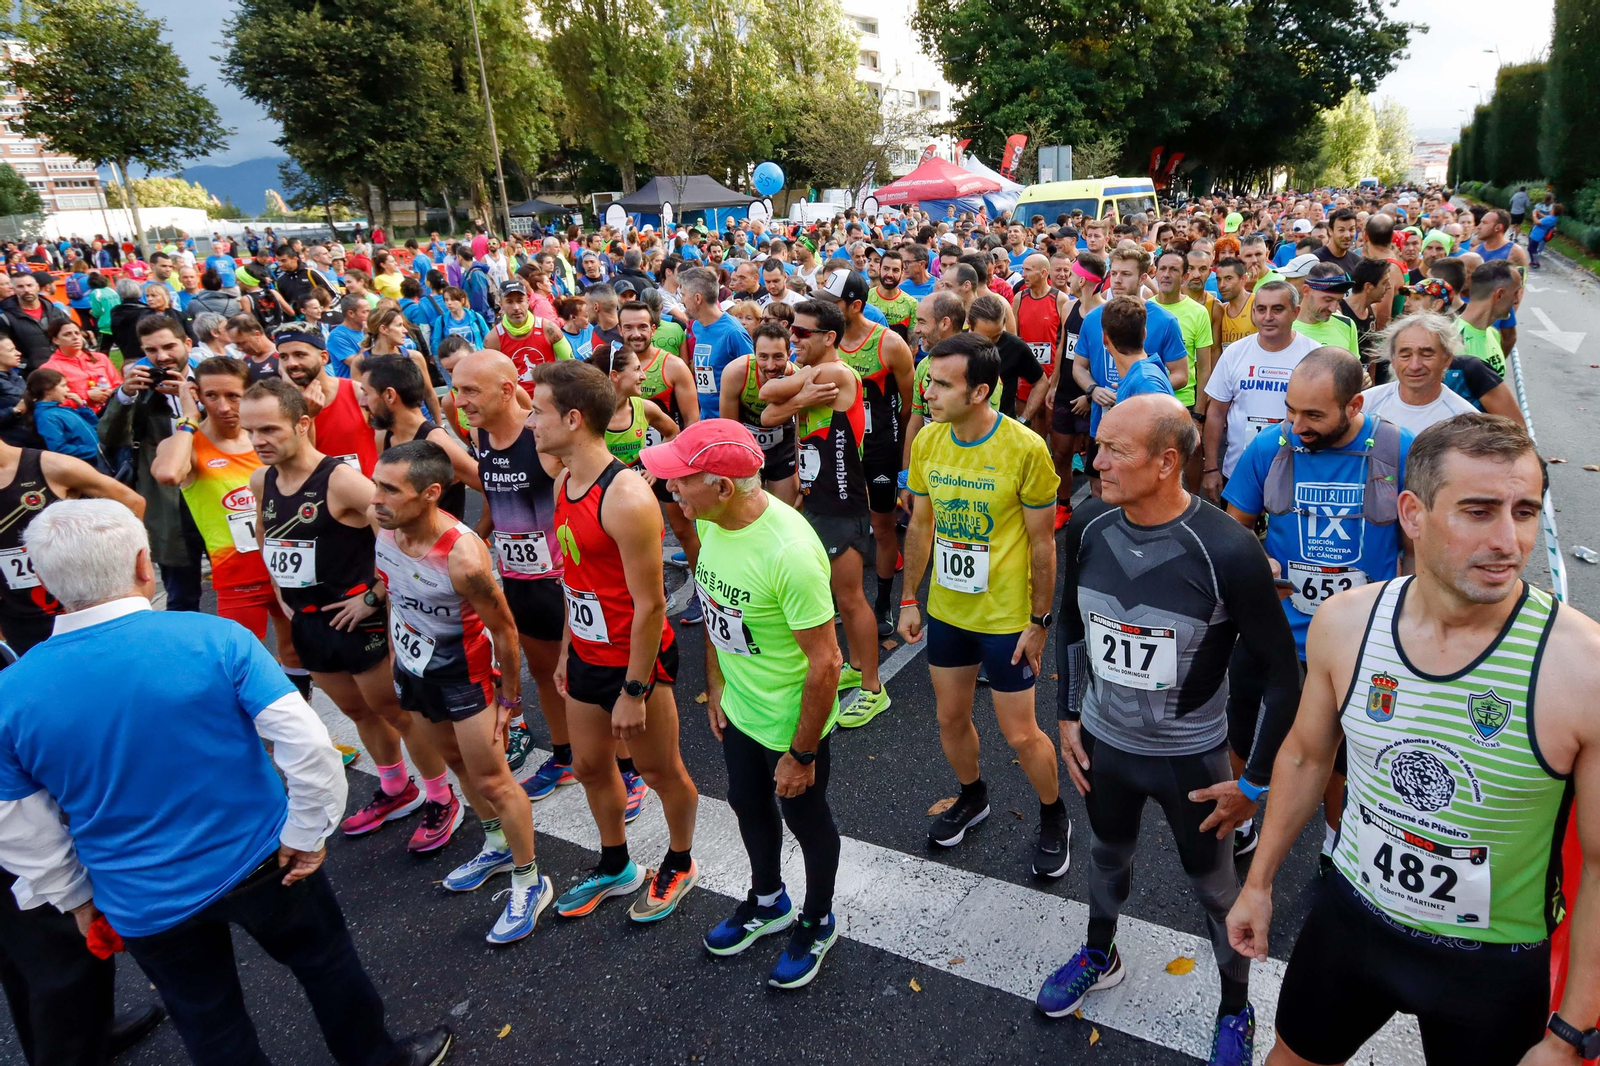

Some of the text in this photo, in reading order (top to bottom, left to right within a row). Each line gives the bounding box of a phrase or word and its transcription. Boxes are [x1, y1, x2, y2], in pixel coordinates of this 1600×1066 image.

[1033, 348, 1045, 358] 37
[1240, 380, 1288, 392] RUNNIN
[646, 434, 653, 446] 5
[799, 454, 806, 469] 4
[492, 472, 527, 483] BARCO
[929, 470, 995, 491] mediolanum
[229, 495, 256, 507] Serr
[973, 501, 989, 513] 15K
[1308, 506, 1351, 540] IX
[503, 543, 538, 562] 238
[1317, 552, 1342, 560] CÁNCER
[270, 551, 303, 573] 489
[942, 551, 975, 579] 108
[394, 623, 421, 659] 546
[1103, 634, 1158, 671] 217
[1468, 734, 1501, 748] SANTOMÉ
[1463, 763, 1474, 778] Man
[1378, 803, 1469, 839] Santomé de Piñeiro
[1401, 842, 1419, 853] CONTRA
[1373, 842, 1458, 903] 482
[1379, 884, 1406, 899] Roberto
[1406, 895, 1445, 911] MARTINEZ
